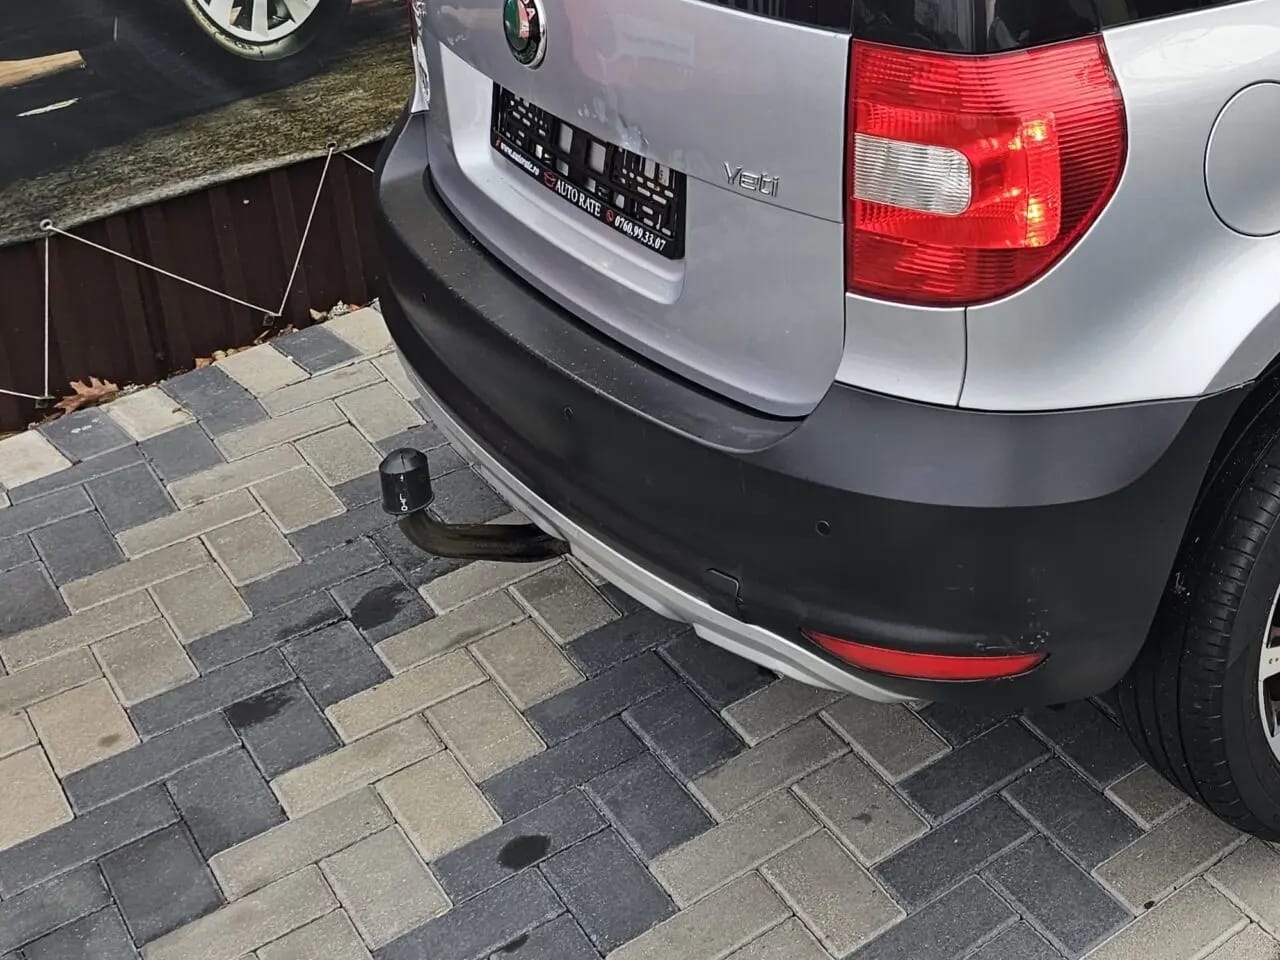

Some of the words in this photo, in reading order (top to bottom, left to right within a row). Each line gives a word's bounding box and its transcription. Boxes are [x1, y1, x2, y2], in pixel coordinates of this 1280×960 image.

[723, 161, 779, 198] Yeti
[555, 179, 578, 202] AUTO
[579, 193, 602, 217] RATE
[614, 215, 667, 251] 0760.99.33.07
